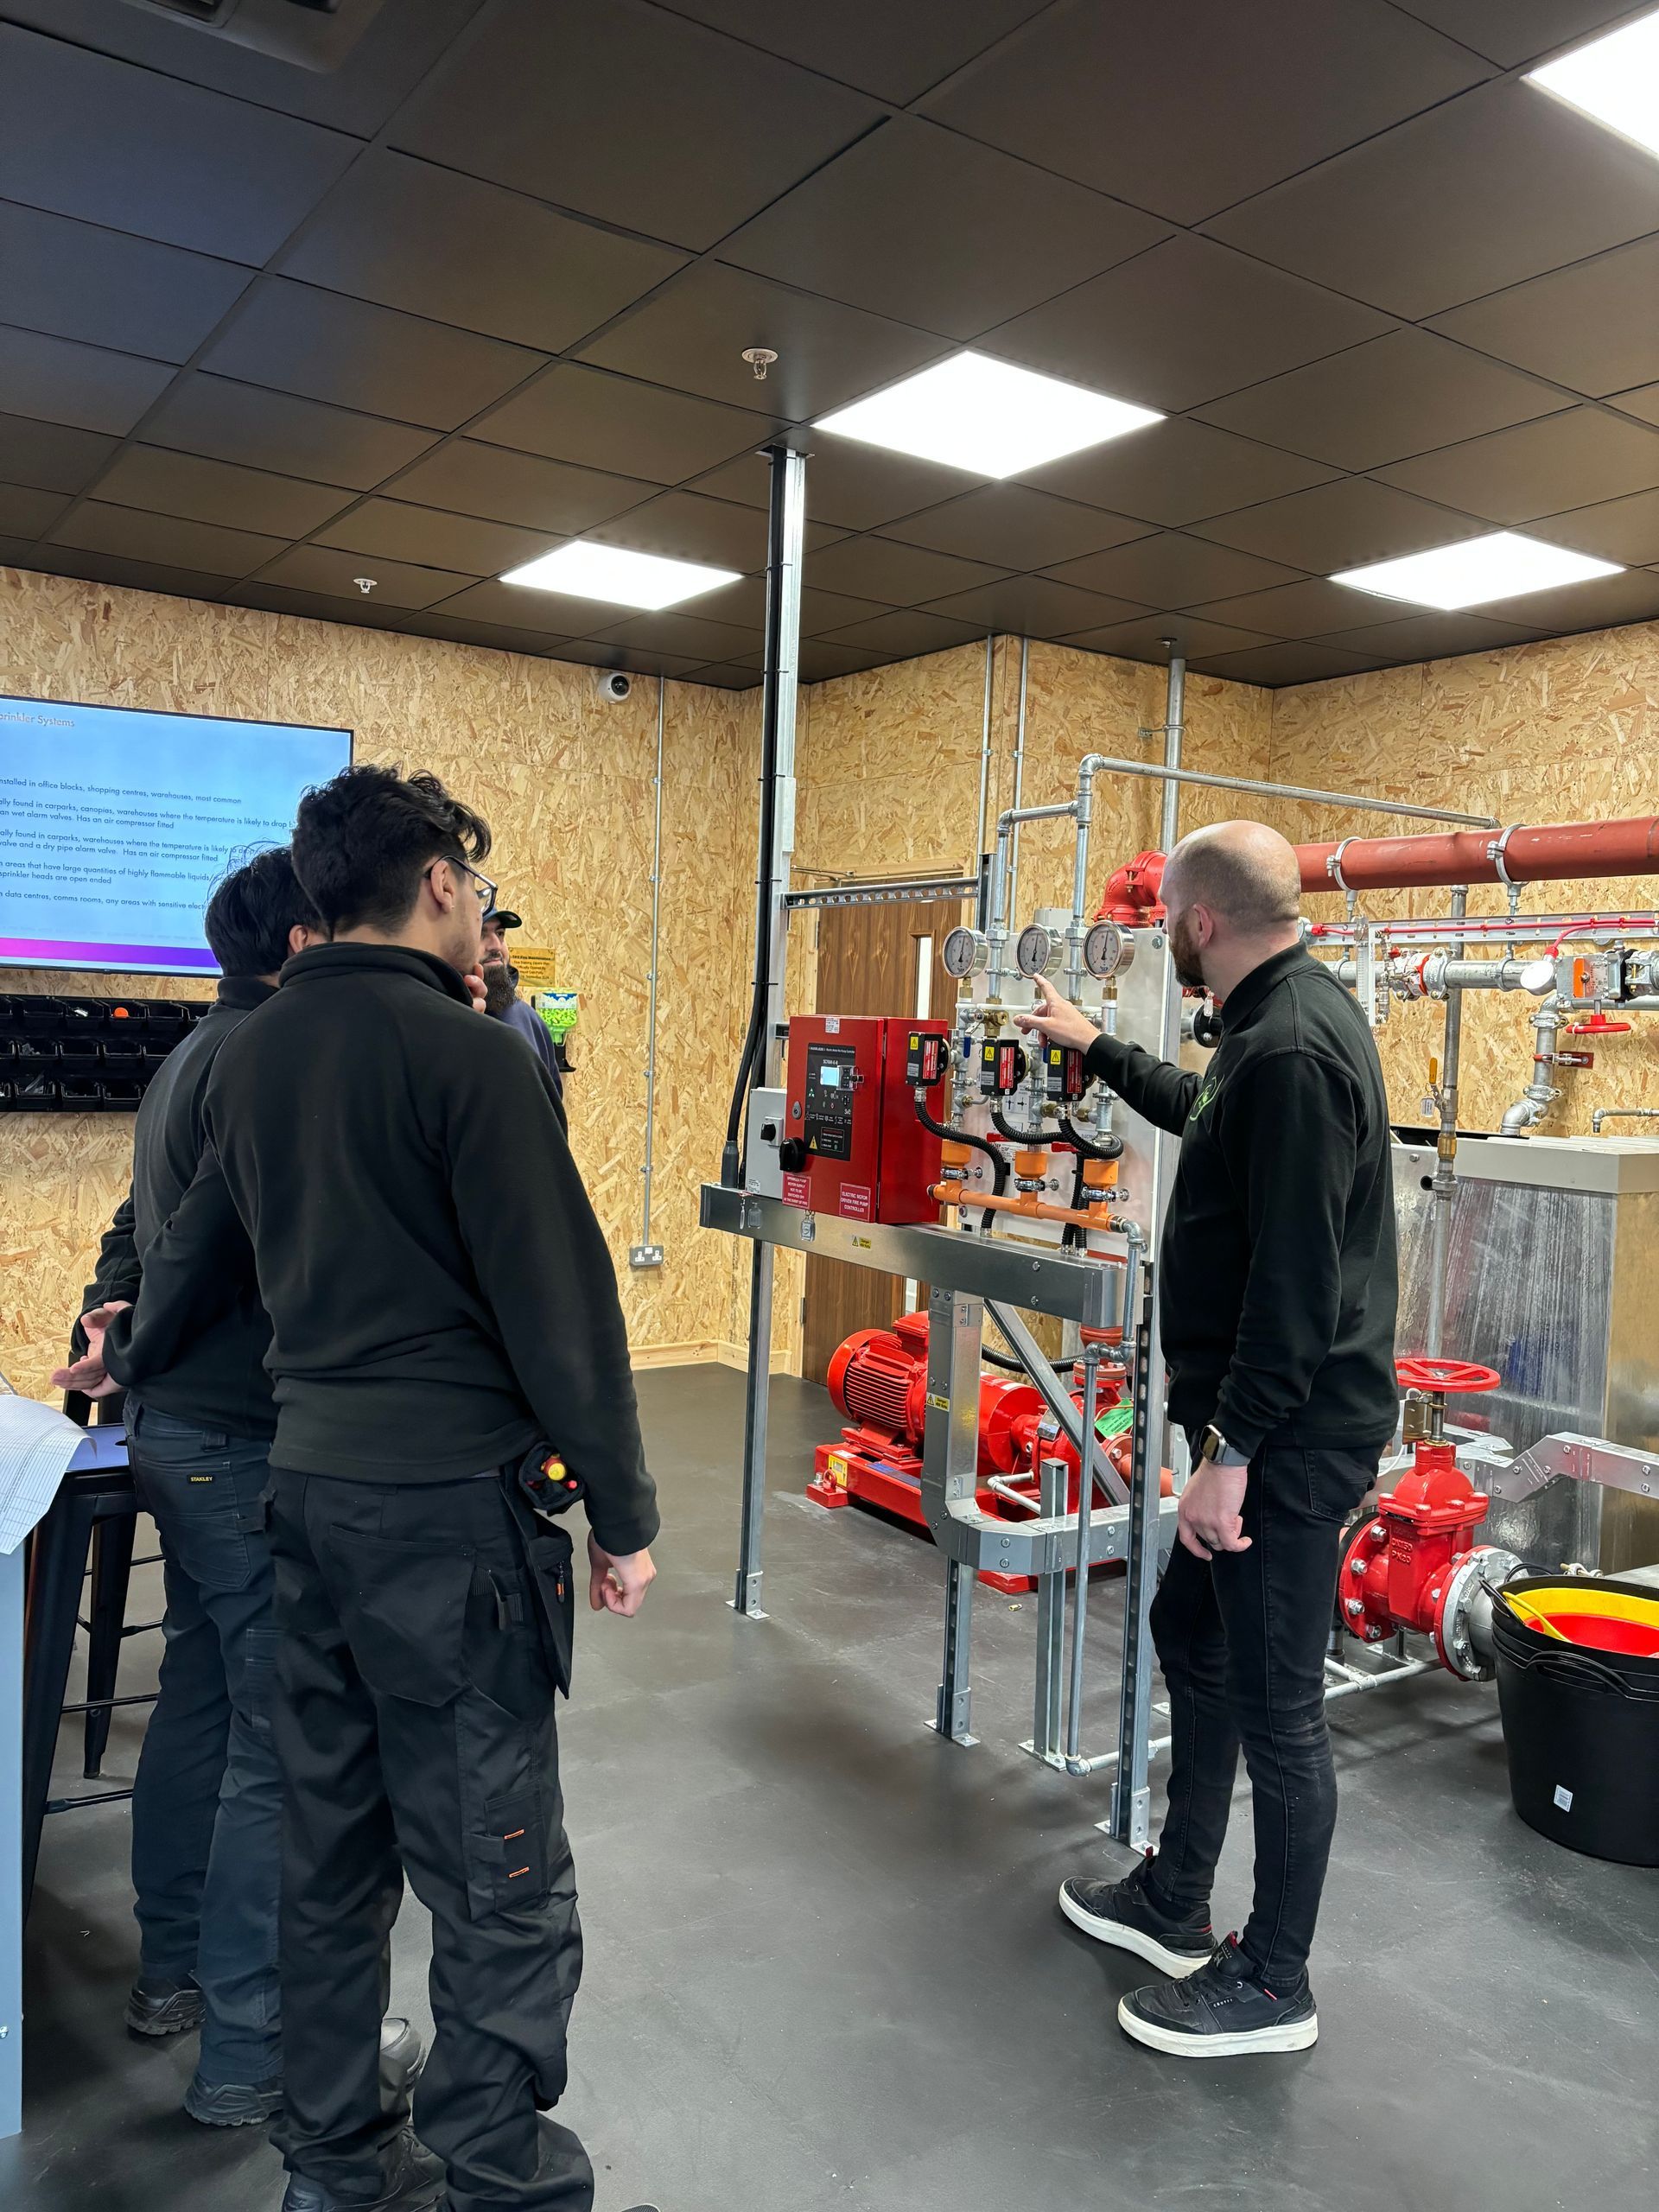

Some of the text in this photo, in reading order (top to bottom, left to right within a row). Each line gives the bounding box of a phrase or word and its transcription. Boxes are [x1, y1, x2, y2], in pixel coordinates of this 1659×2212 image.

[37, 715, 75, 727] Systems
[38, 780, 58, 789] office
[60, 782, 86, 791] blocks,
[87, 785, 120, 795] shopping
[122, 789, 149, 798] centres,
[150, 791, 194, 801] warehouses,
[13, 798, 34, 807] found
[44, 803, 79, 812] carparks,
[80, 805, 115, 815] canopies,
[117, 808, 158, 818] warehouses
[159, 810, 181, 819] where
[195, 815, 235, 823] temperature
[244, 817, 262, 827] likely
[270, 819, 287, 829] drop
[27, 810, 48, 819] alarm
[157, 820, 175, 829] fitted
[15, 830, 36, 838] found
[47, 833, 81, 842] carparks,
[82, 836, 124, 845] warehouses
[125, 838, 148, 847] where
[162, 842, 202, 851] temperature
[211, 844, 229, 854] likely
[42, 842, 55, 851] dry
[75, 844, 96, 853] alarm
[201, 853, 219, 861] fitted
[28, 861, 41, 869] that
[43, 861, 61, 871] have
[62, 864, 82, 874] large
[83, 866, 117, 875] quantities
[127, 868, 149, 878] highly
[150, 869, 187, 880] flammable
[32, 871, 54, 880] heads
[89, 875, 111, 884] ended
[5, 889, 22, 898] data
[158, 900, 187, 910] sensitive
